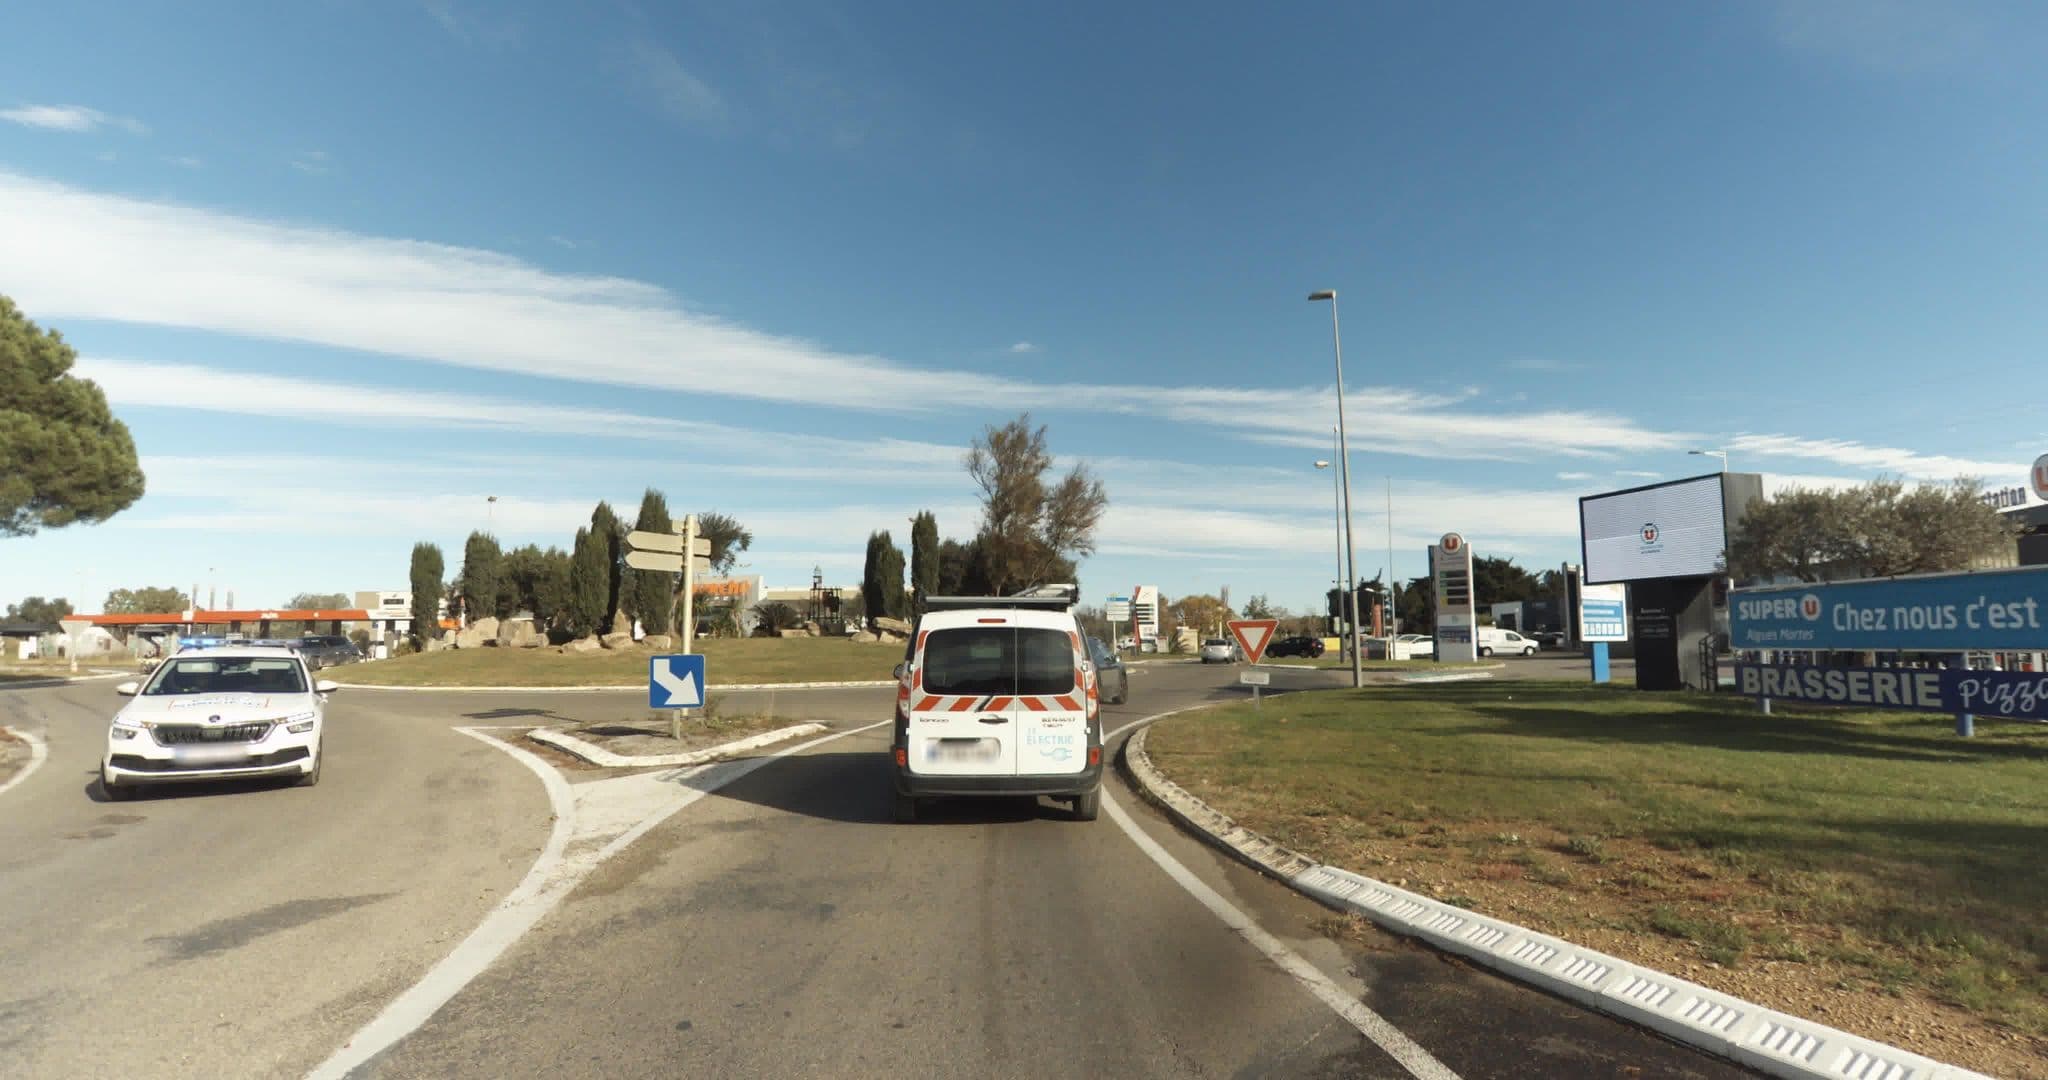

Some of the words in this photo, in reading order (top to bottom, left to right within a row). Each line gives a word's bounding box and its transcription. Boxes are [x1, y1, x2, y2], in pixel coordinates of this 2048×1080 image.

[1980, 486, 2026, 509] tation
[1444, 538, 1459, 550] U
[1739, 598, 1798, 620] SUPER
[1833, 602, 1888, 631] Chez
[1893, 604, 1957, 630] nous
[1966, 596, 2040, 629] c'est
[1742, 666, 1943, 707] BRASSERIE
